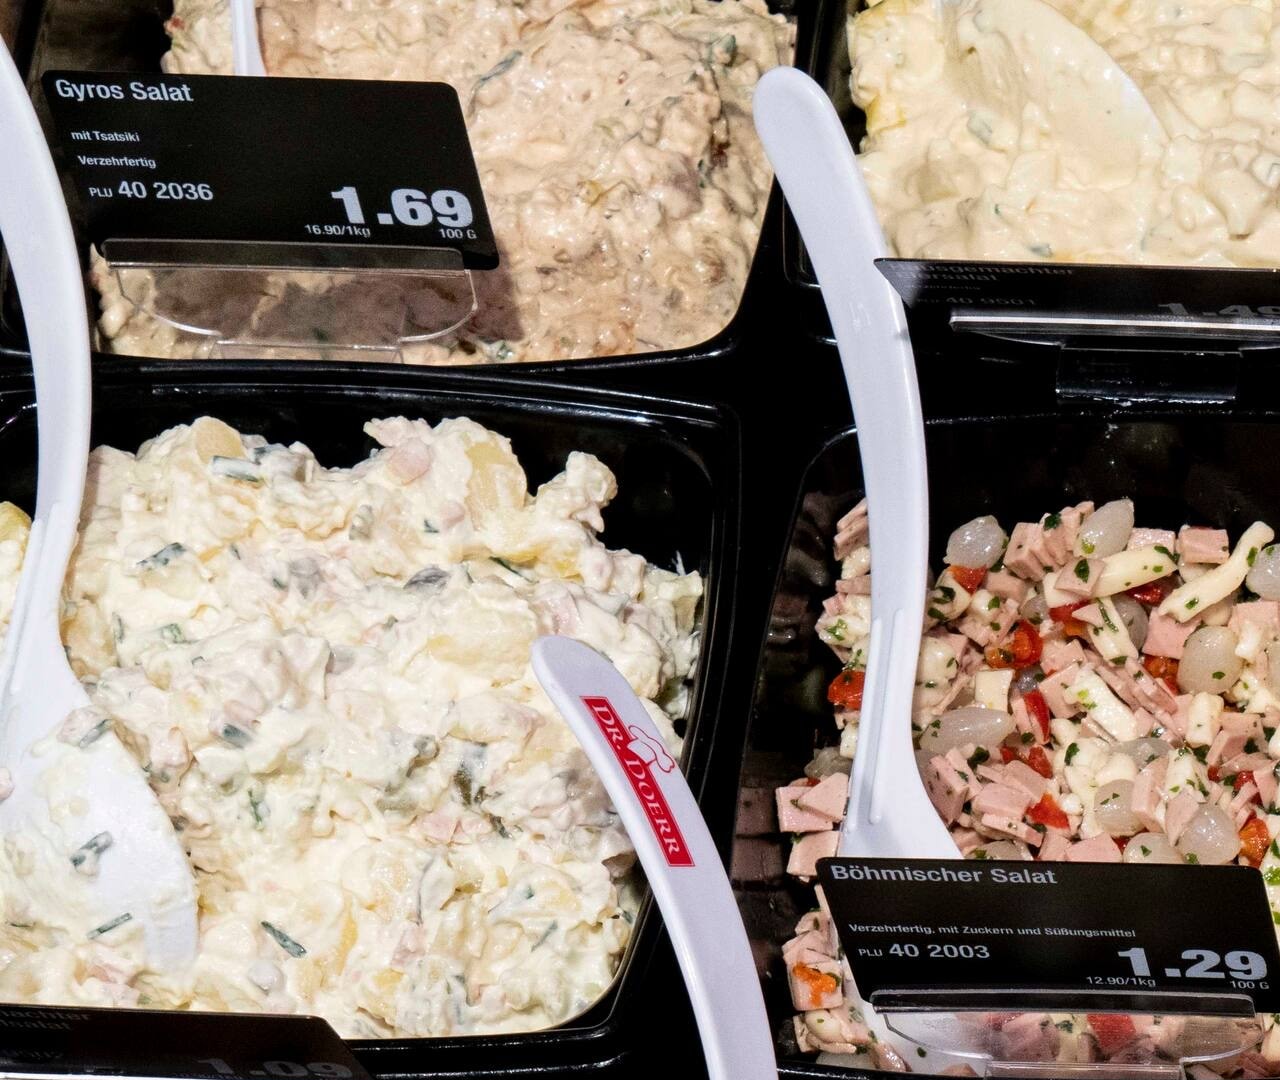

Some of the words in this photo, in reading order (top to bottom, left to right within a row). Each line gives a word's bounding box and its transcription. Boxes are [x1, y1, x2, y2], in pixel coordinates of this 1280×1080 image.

[55, 79, 125, 102] Gyros
[129, 81, 195, 102] Salat
[70, 130, 93, 141] mit
[94, 130, 140, 142] Tsatsiki
[77, 155, 157, 170] Verzehrfertig
[88, 187, 113, 198] PLU
[117, 180, 148, 199] 40
[153, 181, 214, 201] 2036
[330, 186, 474, 228] 1.69
[304, 224, 371, 238] 16.90/1kg
[439, 228, 464, 239] 100
[466, 228, 478, 240] G
[592, 704, 624, 751] DR.
[625, 758, 680, 854] DOERR
[830, 864, 983, 883] Böhmischer
[990, 868, 1058, 884] Salat
[937, 925, 960, 934] mit
[962, 925, 1014, 935] Zuckern
[1016, 927, 1042, 936] und
[857, 948, 883, 957] PLU
[888, 943, 920, 958] 40
[928, 944, 991, 959] 2003
[1116, 947, 1268, 982] 1.29
[1086, 976, 1157, 988] 12.90/1kg
[1229, 980, 1256, 989] 100
[1259, 981, 1270, 990] G
[198, 1058, 352, 1078] 1.09
